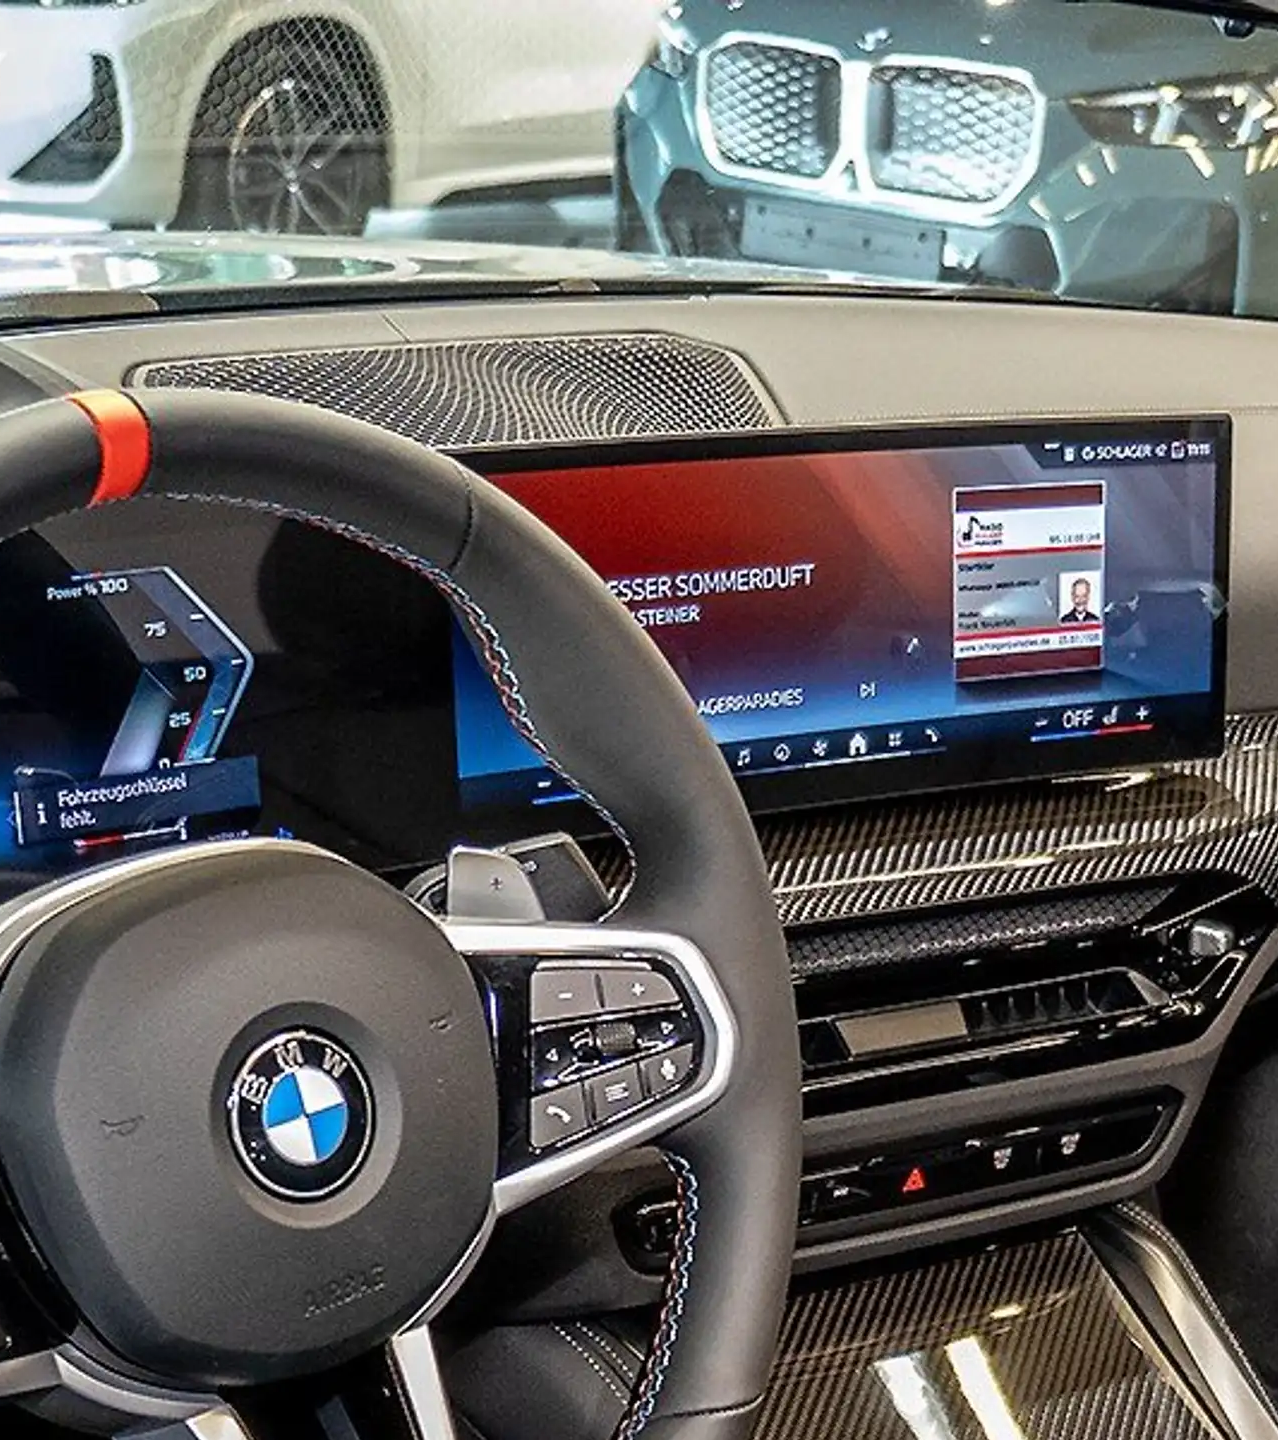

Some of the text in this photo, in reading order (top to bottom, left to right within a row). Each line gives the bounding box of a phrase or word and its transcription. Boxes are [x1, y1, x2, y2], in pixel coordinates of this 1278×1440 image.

[101, 578, 128, 594] 100
[675, 563, 815, 598] SOMMERDUFT
[637, 604, 701, 628] STEINER
[144, 621, 167, 638] 75
[183, 666, 207, 682] 50
[169, 711, 192, 728] 25
[1062, 708, 1094, 729] OFF
[241, 1040, 349, 1104] BMW
